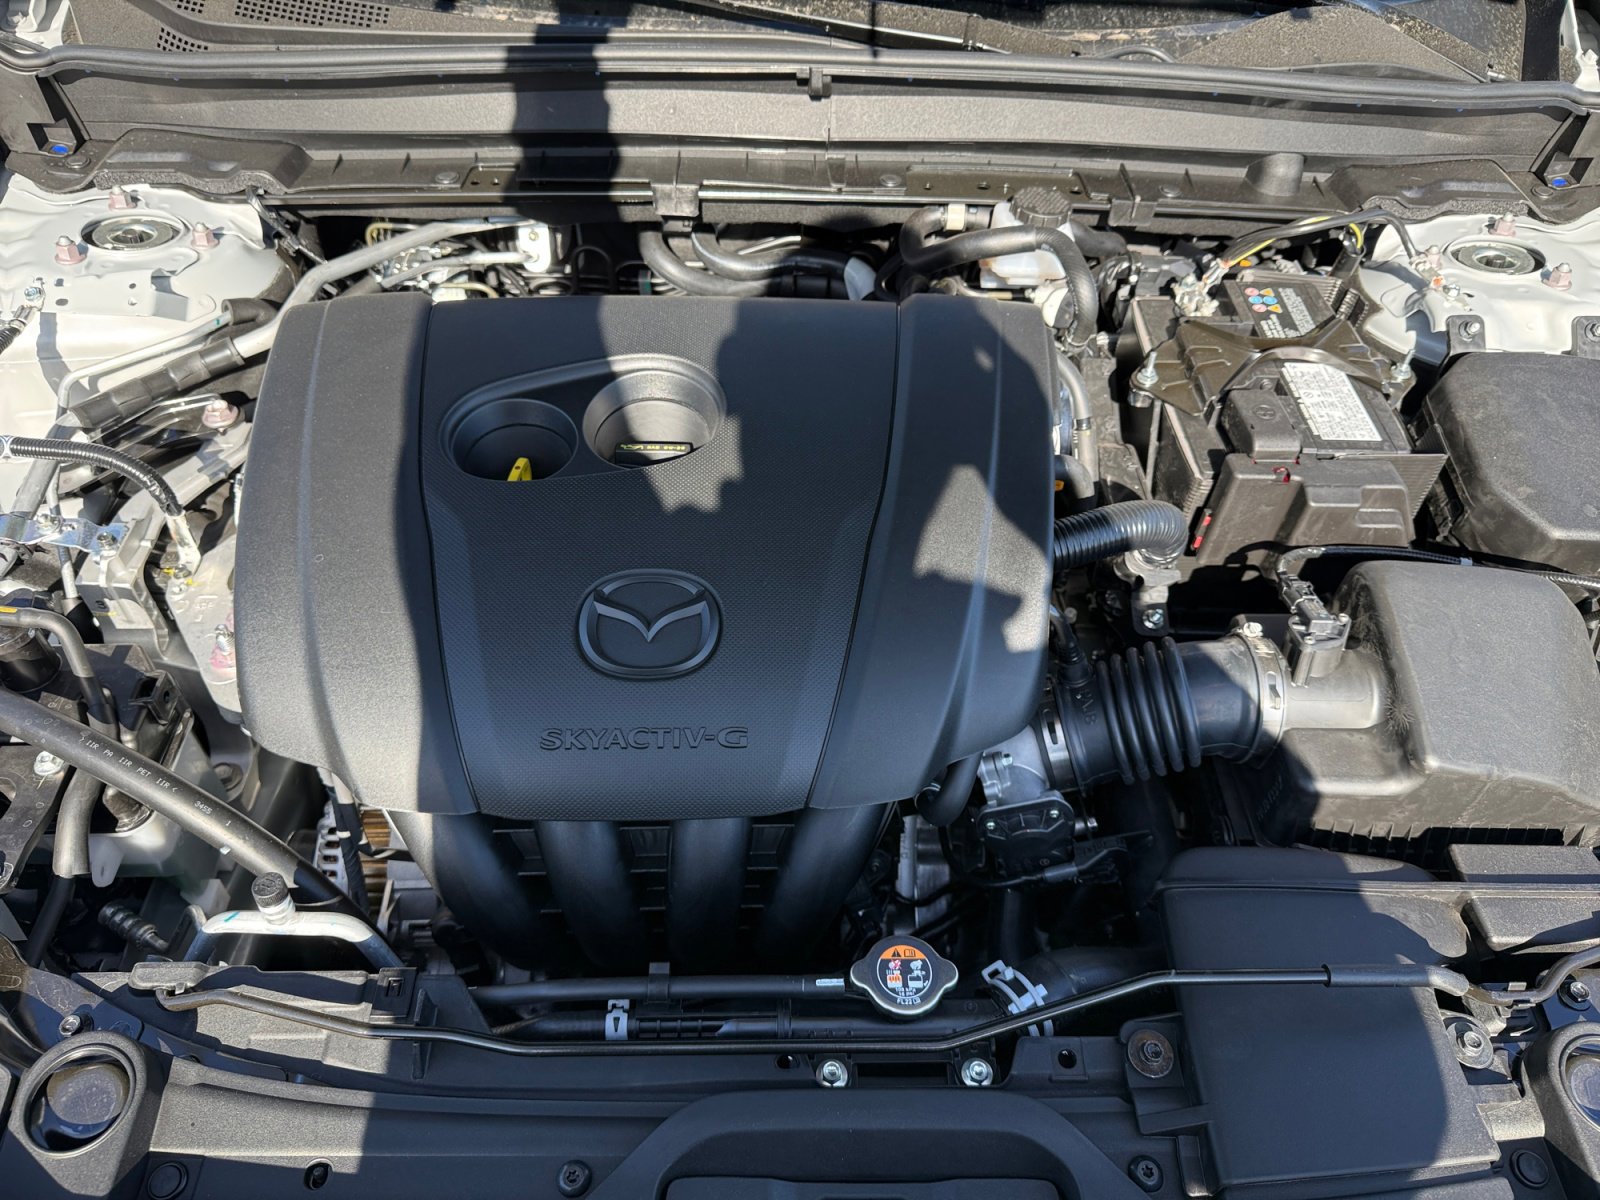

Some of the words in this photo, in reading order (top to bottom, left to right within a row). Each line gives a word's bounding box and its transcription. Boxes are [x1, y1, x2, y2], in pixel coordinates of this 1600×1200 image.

[540, 727, 749, 750] SKYACTIV-G
[86, 739, 100, 750] IIR
[103, 748, 114, 758] PA
[118, 756, 133, 768] IIR
[136, 767, 152, 778] PET
[156, 778, 170, 788] IIR
